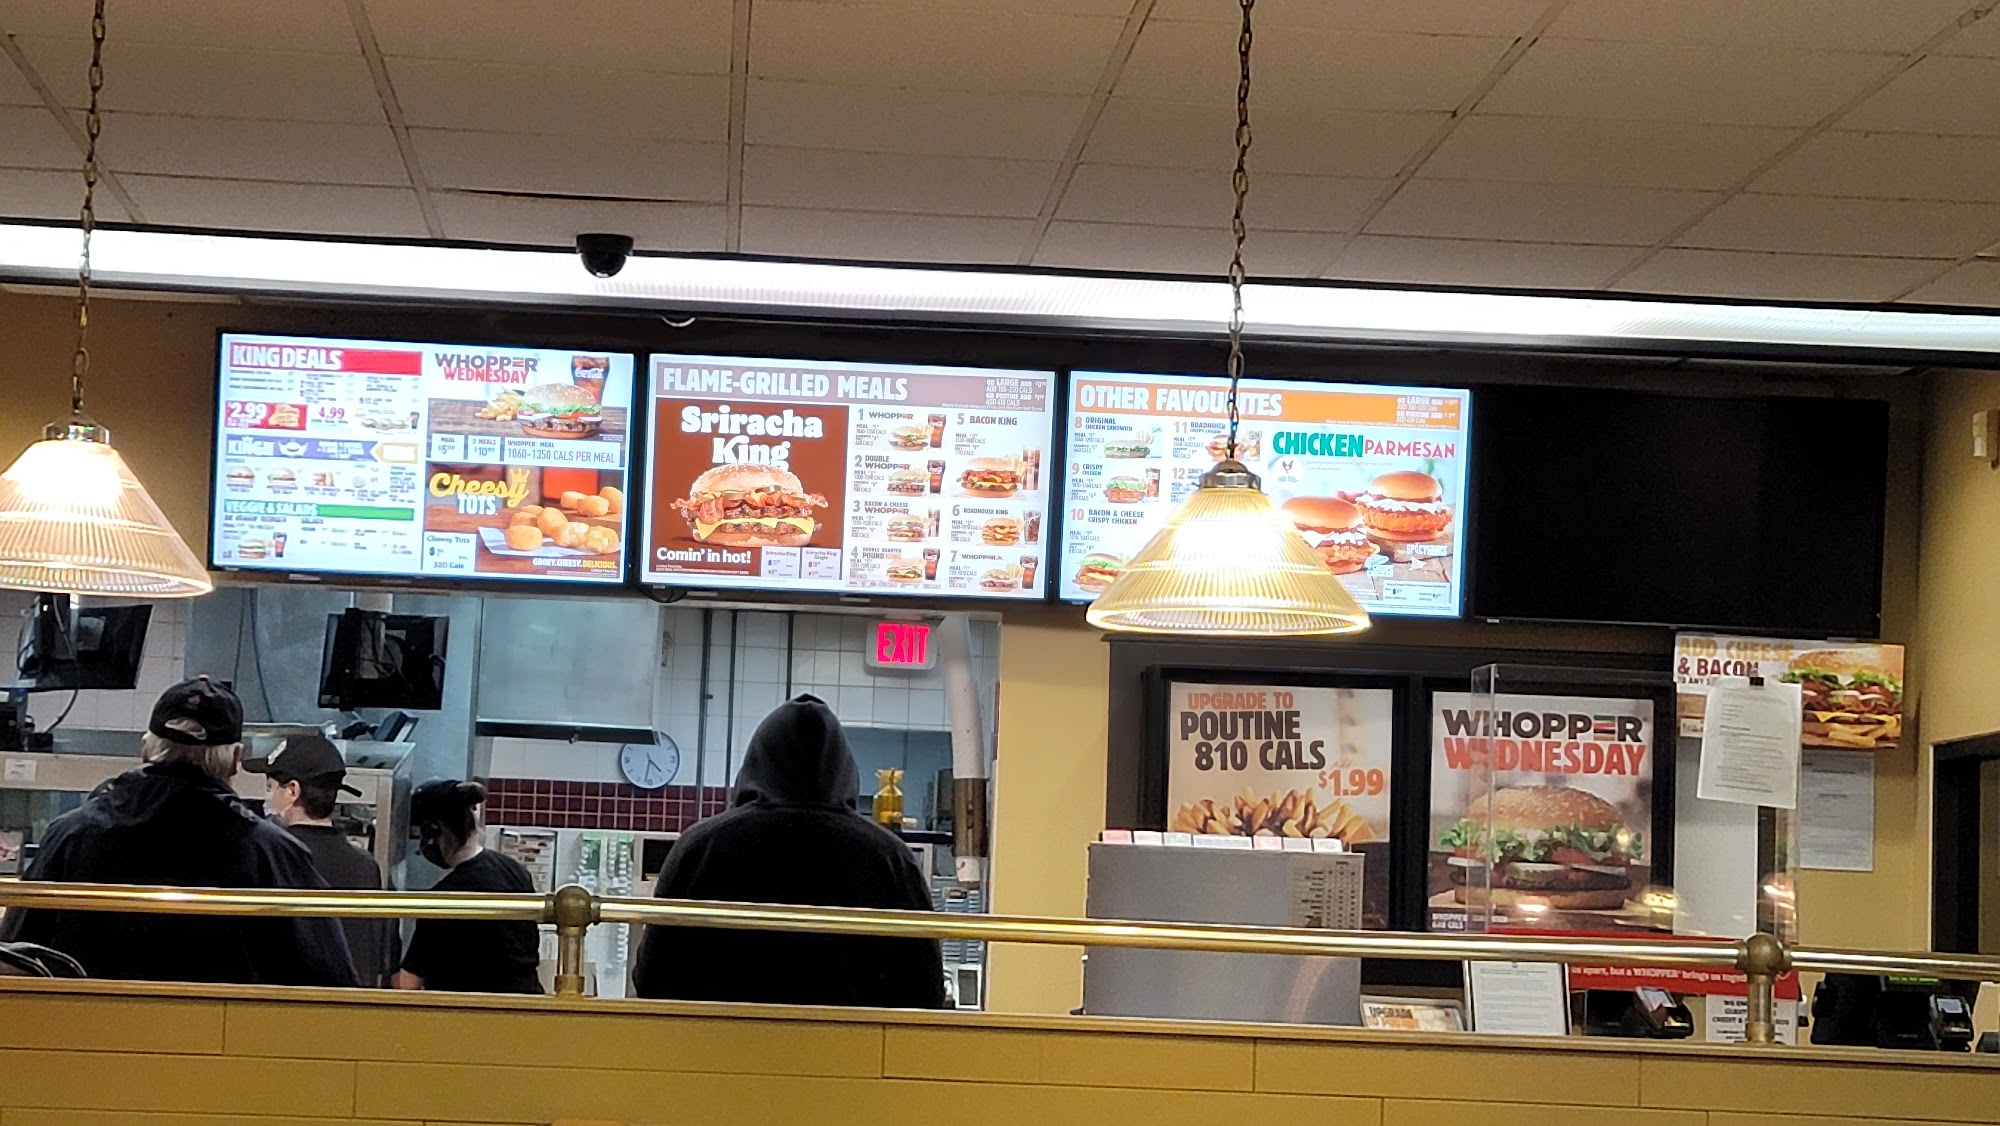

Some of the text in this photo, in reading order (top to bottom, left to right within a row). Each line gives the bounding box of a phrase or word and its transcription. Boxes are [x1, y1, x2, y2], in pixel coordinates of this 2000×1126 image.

[232, 344, 343, 370] KING DEALS
[435, 353, 537, 372] WHOPPER
[443, 366, 529, 384] WEDNESDAY
[996, 378, 1019, 386] LARGE
[664, 368, 907, 400] FLAME-GRILLED MEALS
[1080, 385, 1149, 410] OTHER
[1407, 396, 1430, 404] LARGE
[681, 405, 823, 438] Sriracha
[858, 408, 913, 420] 1 WHOPPER
[957, 413, 1017, 425] 5 BACON KING
[1075, 416, 1082, 428] 8
[1174, 421, 1187, 433] 11
[508, 440, 536, 448] WHOPPER
[1273, 431, 1456, 458] CHICKEN PARMESAN
[508, 448, 616, 463] 1060-1350 CALS PER MEAL
[712, 435, 791, 471] King
[854, 455, 862, 467] 2
[865, 462, 910, 470] WHOPPER
[1072, 463, 1079, 474] 9
[1172, 468, 1185, 479] 12
[429, 472, 529, 508] Cheesy
[853, 500, 860, 512] 3
[952, 504, 960, 516] 6
[1071, 508, 1084, 520] 10
[656, 547, 751, 564] Comin' in hot!
[851, 546, 858, 558] 4
[951, 550, 957, 562] 7
[877, 624, 931, 664] EXIT
[1678, 639, 1794, 661] ADD CHEESE
[1678, 657, 1758, 677] & BACON
[1188, 692, 1294, 710] UPGRADE TO
[1180, 711, 1301, 740] POUTINE
[1442, 709, 1643, 742] WHOPPER
[1195, 740, 1326, 771] 810 CALS
[1319, 769, 1383, 796] $1.99
[1633, 968, 1678, 977] WHOPPER
